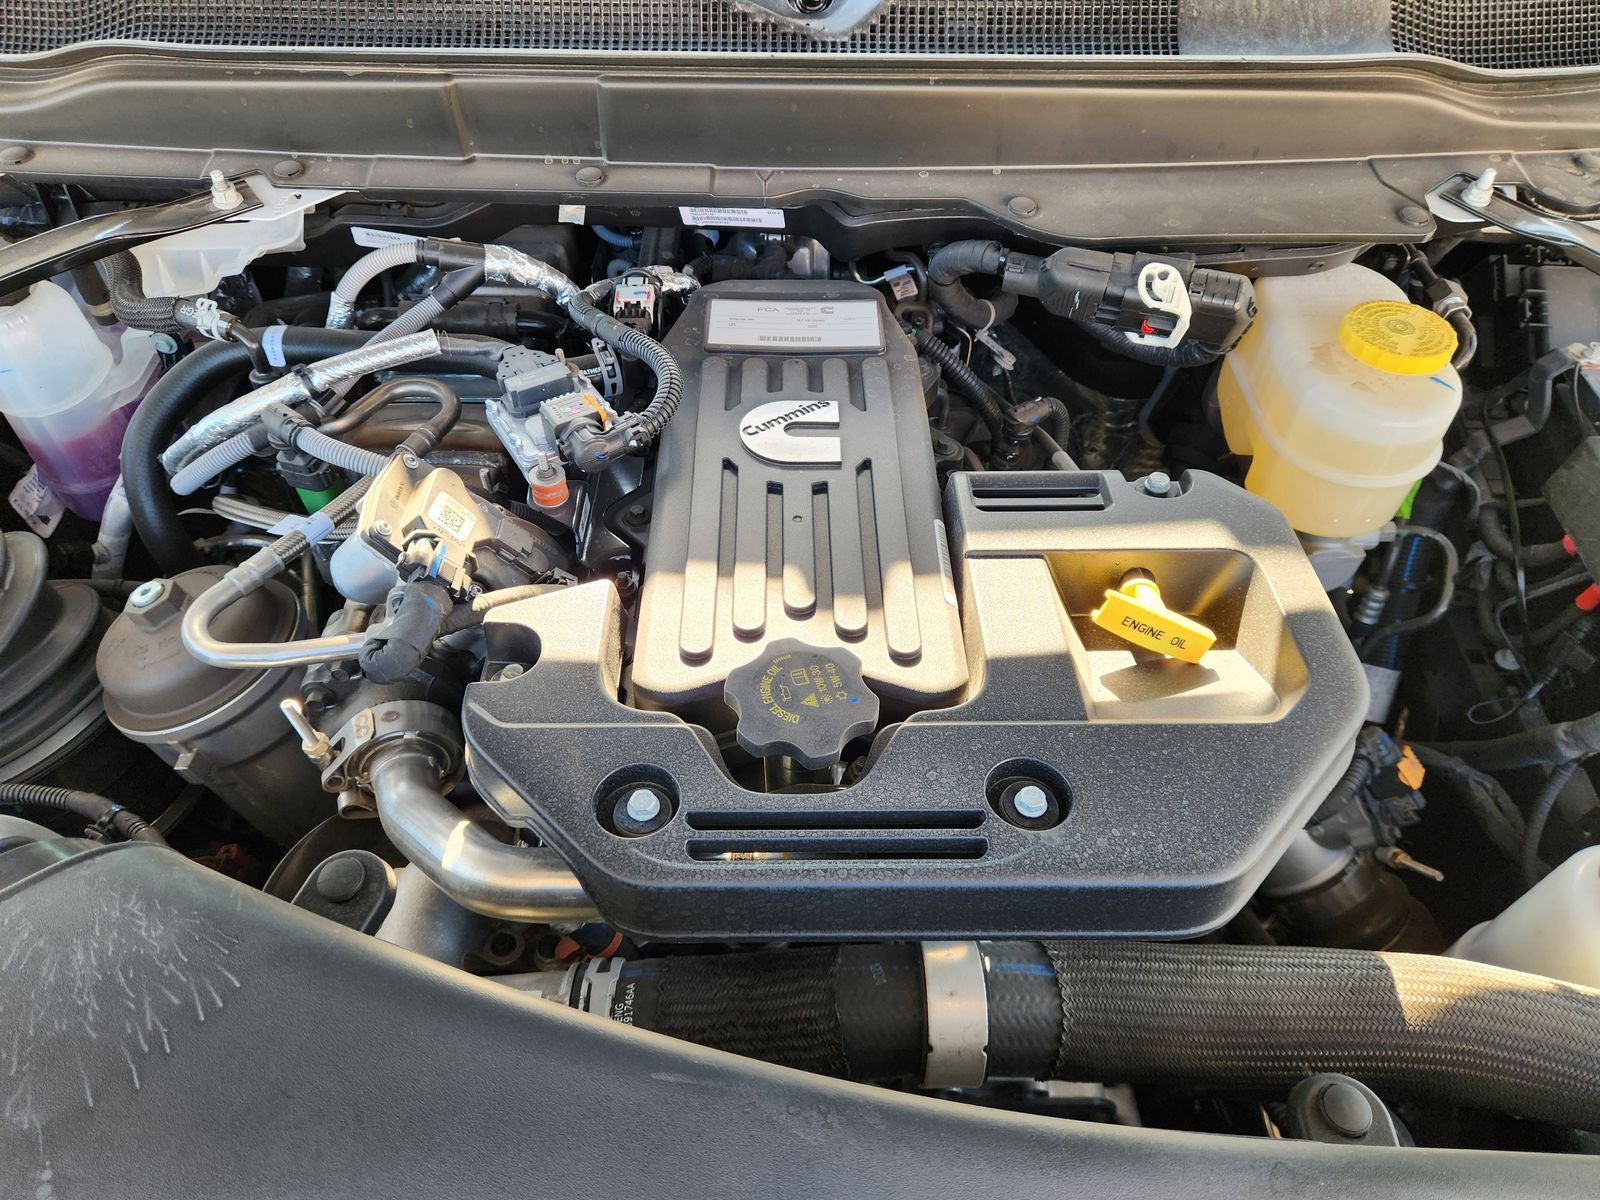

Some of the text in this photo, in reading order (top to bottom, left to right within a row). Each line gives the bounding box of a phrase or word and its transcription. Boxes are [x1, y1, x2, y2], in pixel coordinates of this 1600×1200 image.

[742, 399, 831, 436] Cummins
[1121, 616, 1187, 650] ENGINE OIL
[767, 665, 783, 678] OIL
[760, 675, 774, 705] ENGINE
[769, 702, 800, 724] DIESEL
